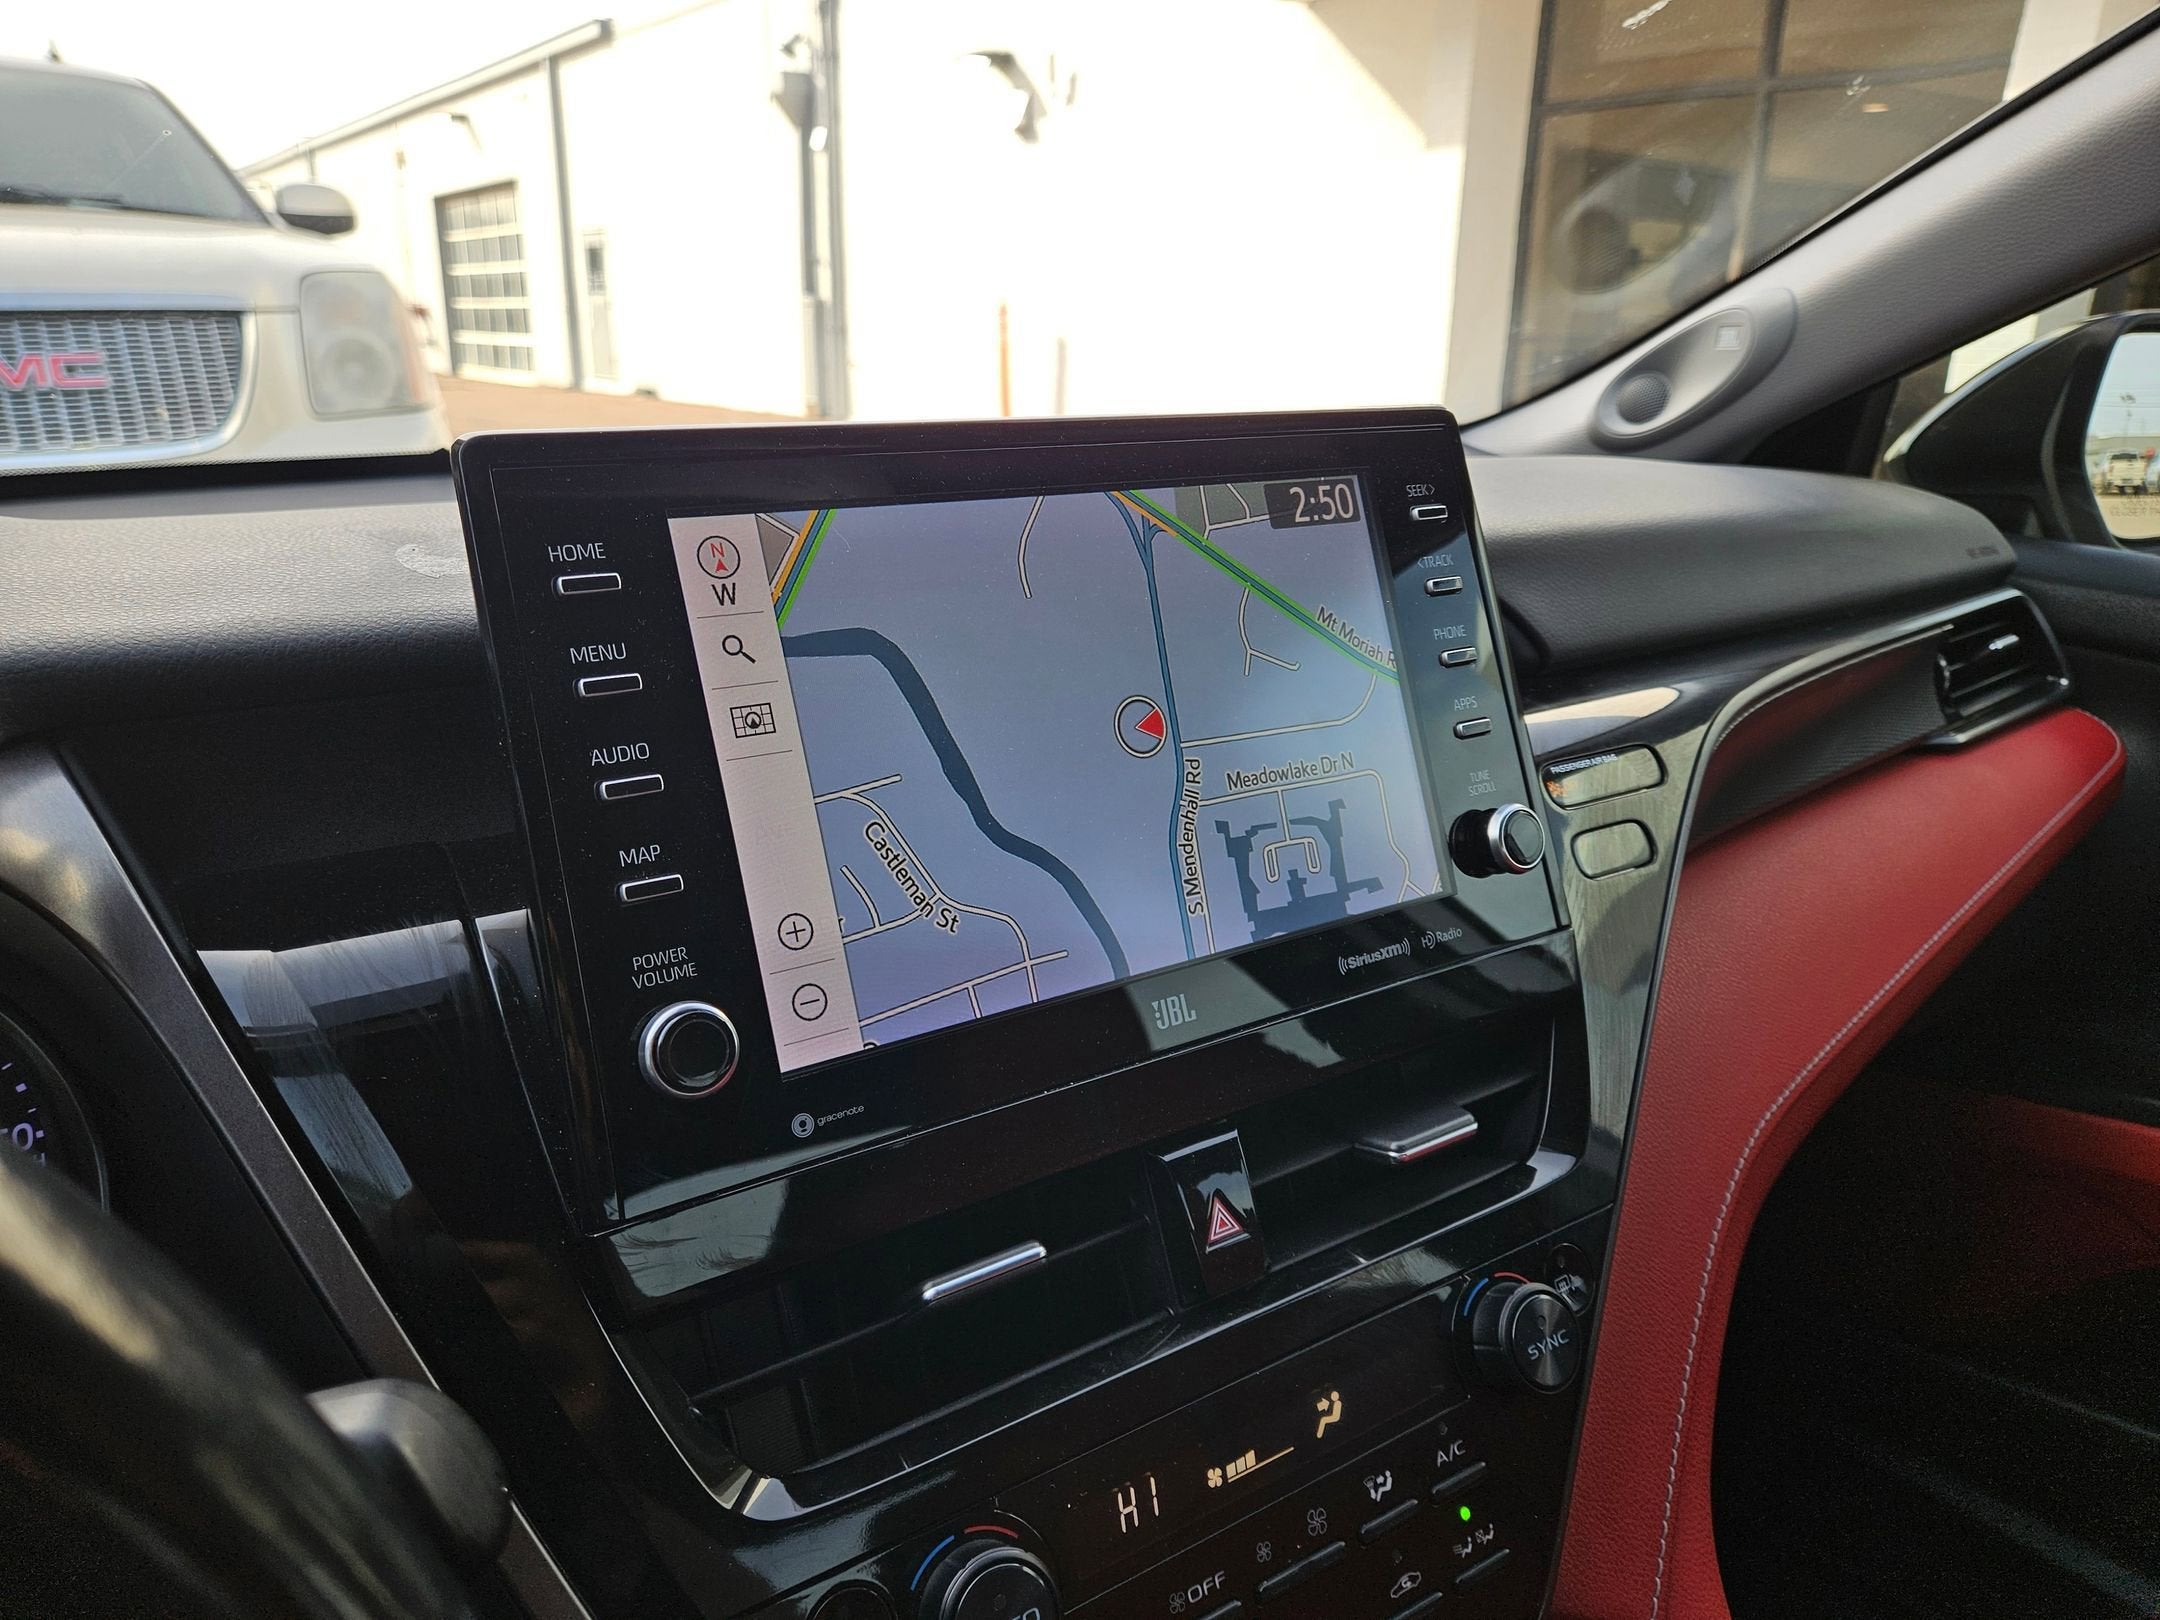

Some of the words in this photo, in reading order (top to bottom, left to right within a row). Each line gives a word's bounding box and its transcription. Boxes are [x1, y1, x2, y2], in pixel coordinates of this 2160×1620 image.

[0, 351, 112, 391] MC
[1289, 483, 1354, 523] 2:50
[548, 542, 606, 563] HOME
[710, 542, 725, 559] N
[711, 582, 736, 606] W
[1316, 606, 1338, 632] Mt
[1338, 621, 1384, 663] Moriah
[1433, 625, 1467, 641] PHONE
[570, 642, 627, 664] MENU
[1454, 695, 1478, 712] APPS
[591, 742, 650, 766] AUDIO
[1185, 758, 1201, 785] Rd
[1226, 761, 1319, 791] Meadowlake
[1321, 755, 1339, 773] Dr
[1341, 751, 1355, 770] N
[1469, 769, 1490, 784] TUNE
[1468, 781, 1497, 797] SCROLL
[1178, 788, 1202, 898] Mendenhall
[619, 844, 661, 868] MAP
[865, 821, 934, 918] Castleman
[936, 907, 959, 933] St
[1188, 902, 1204, 915] S
[1436, 927, 1463, 943] Radio
[632, 946, 689, 971] POWER
[632, 962, 698, 989] VOLUME
[1152, 993, 1197, 1030] JBL
[817, 1105, 865, 1127] gracenote
[1527, 1329, 1570, 1361] SYNC
[1436, 1439, 1466, 1467] A/C
[1187, 1570, 1226, 1604] OFF
